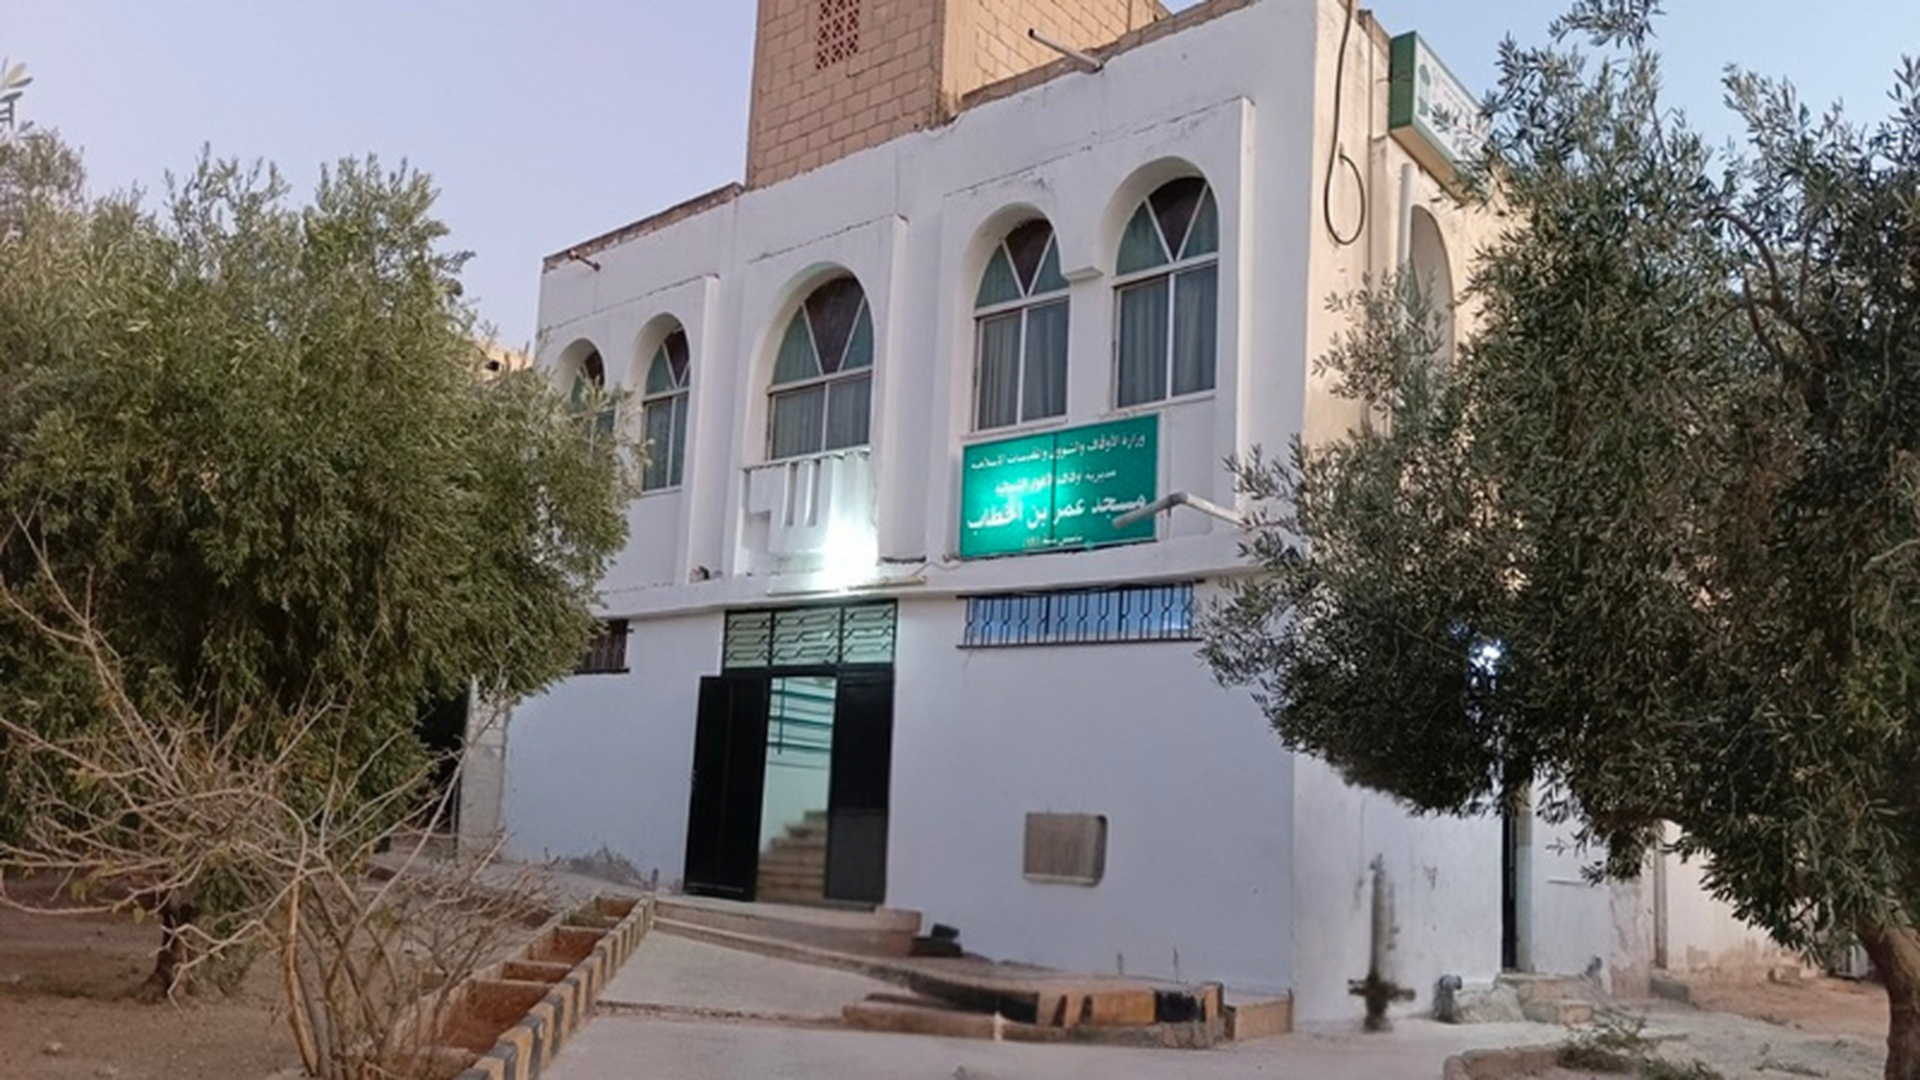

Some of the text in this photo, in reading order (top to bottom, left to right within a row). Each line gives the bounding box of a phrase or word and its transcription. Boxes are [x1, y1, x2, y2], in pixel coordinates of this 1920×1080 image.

[1122, 432, 1145, 449] وزارة
[966, 494, 1147, 536] مسجد عمر بن الخطاب
